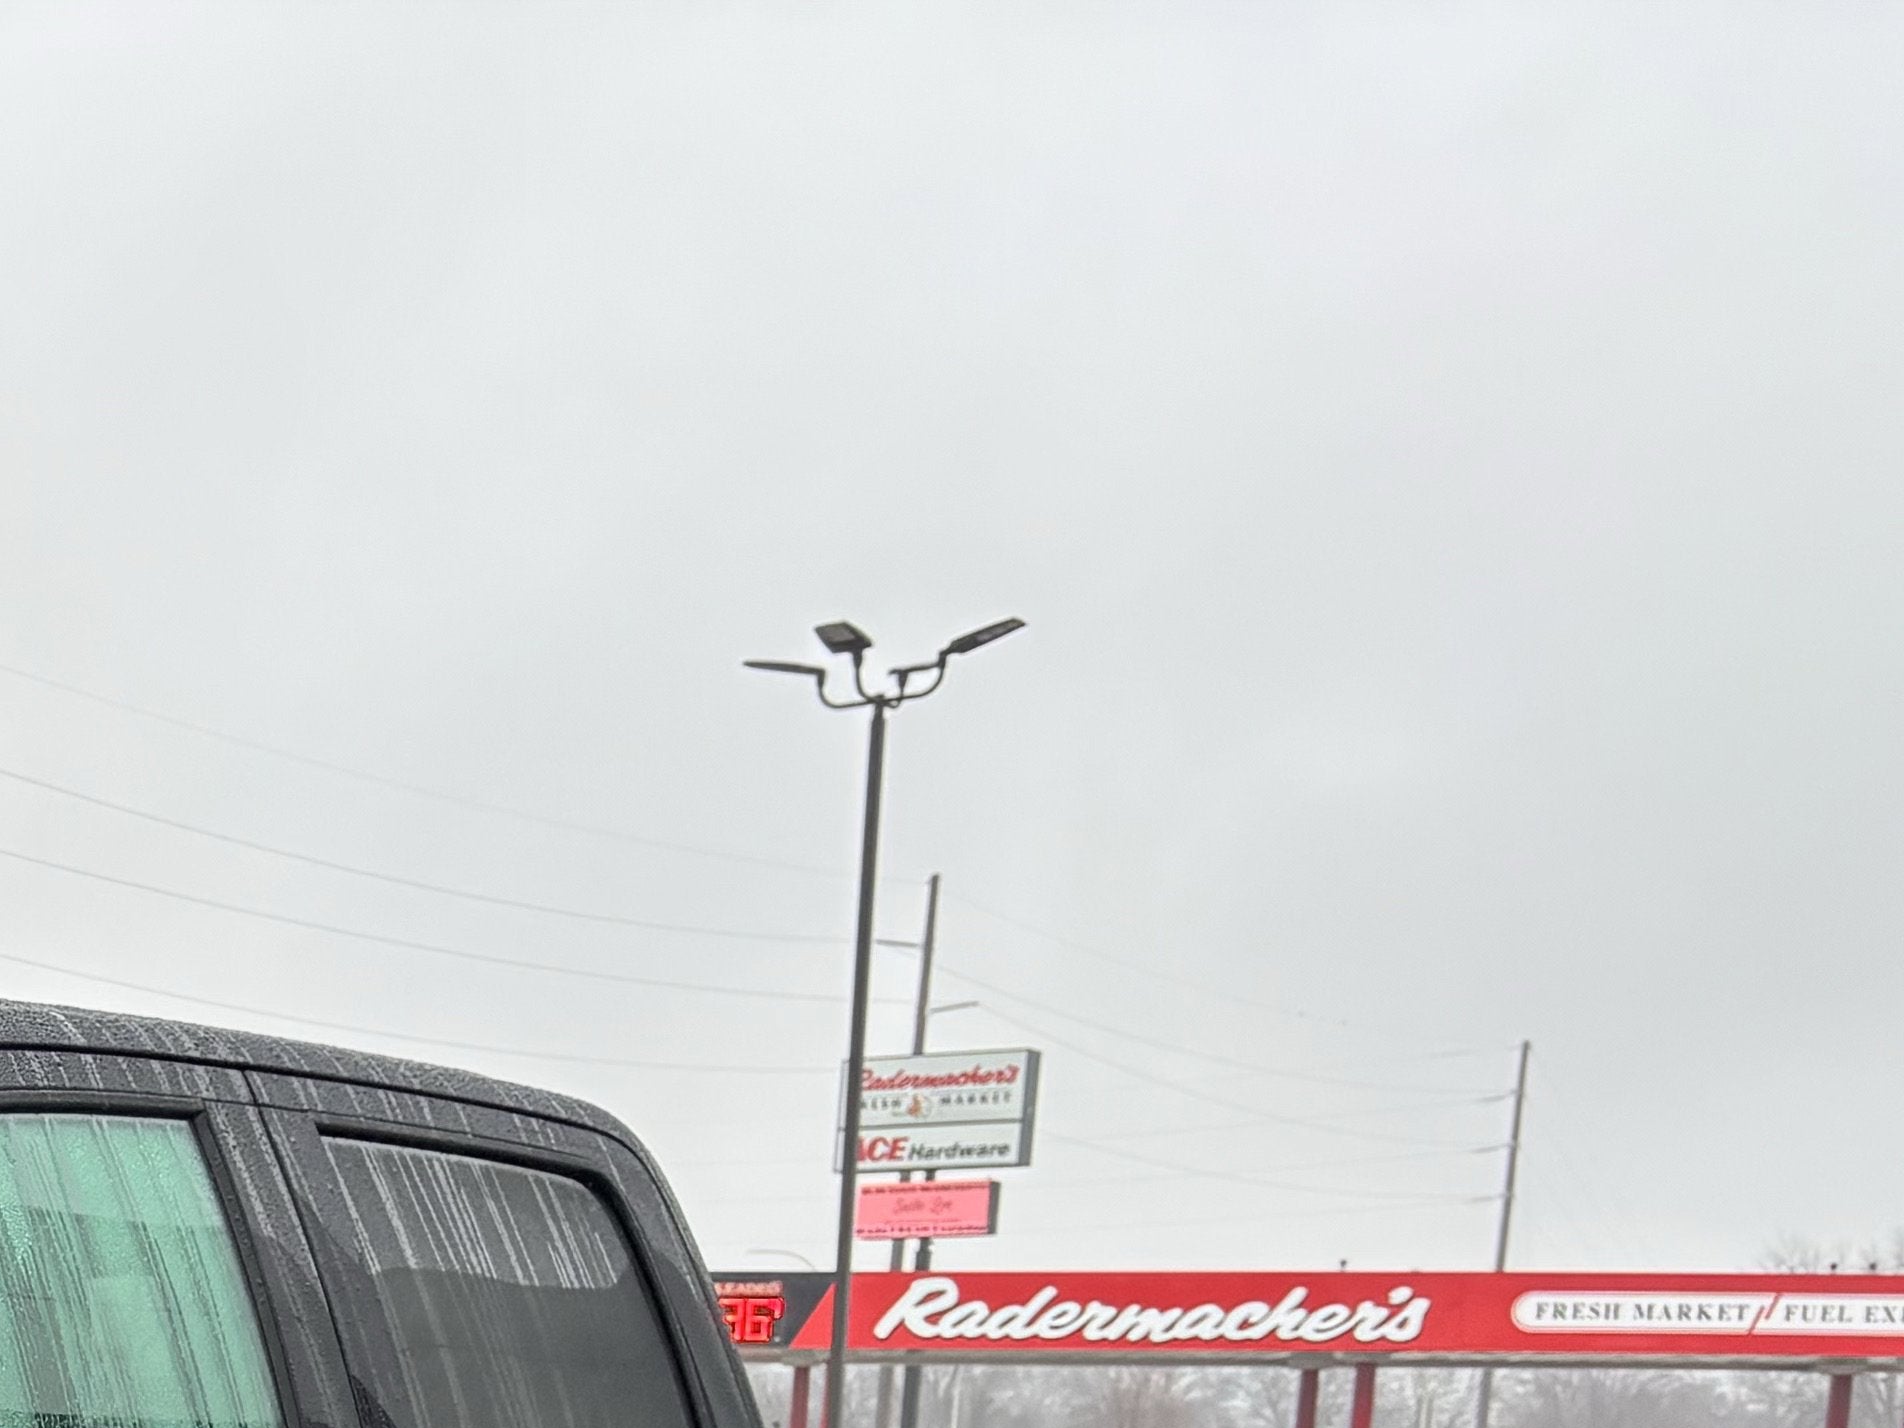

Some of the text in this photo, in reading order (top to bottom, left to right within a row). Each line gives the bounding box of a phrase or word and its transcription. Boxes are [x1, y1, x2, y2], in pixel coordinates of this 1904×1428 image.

[907, 1142, 1010, 1161] Hardware
[873, 1276, 1432, 1342] Radermacher's
[1534, 1302, 1904, 1324] FRESH MARKET FUEL EX
